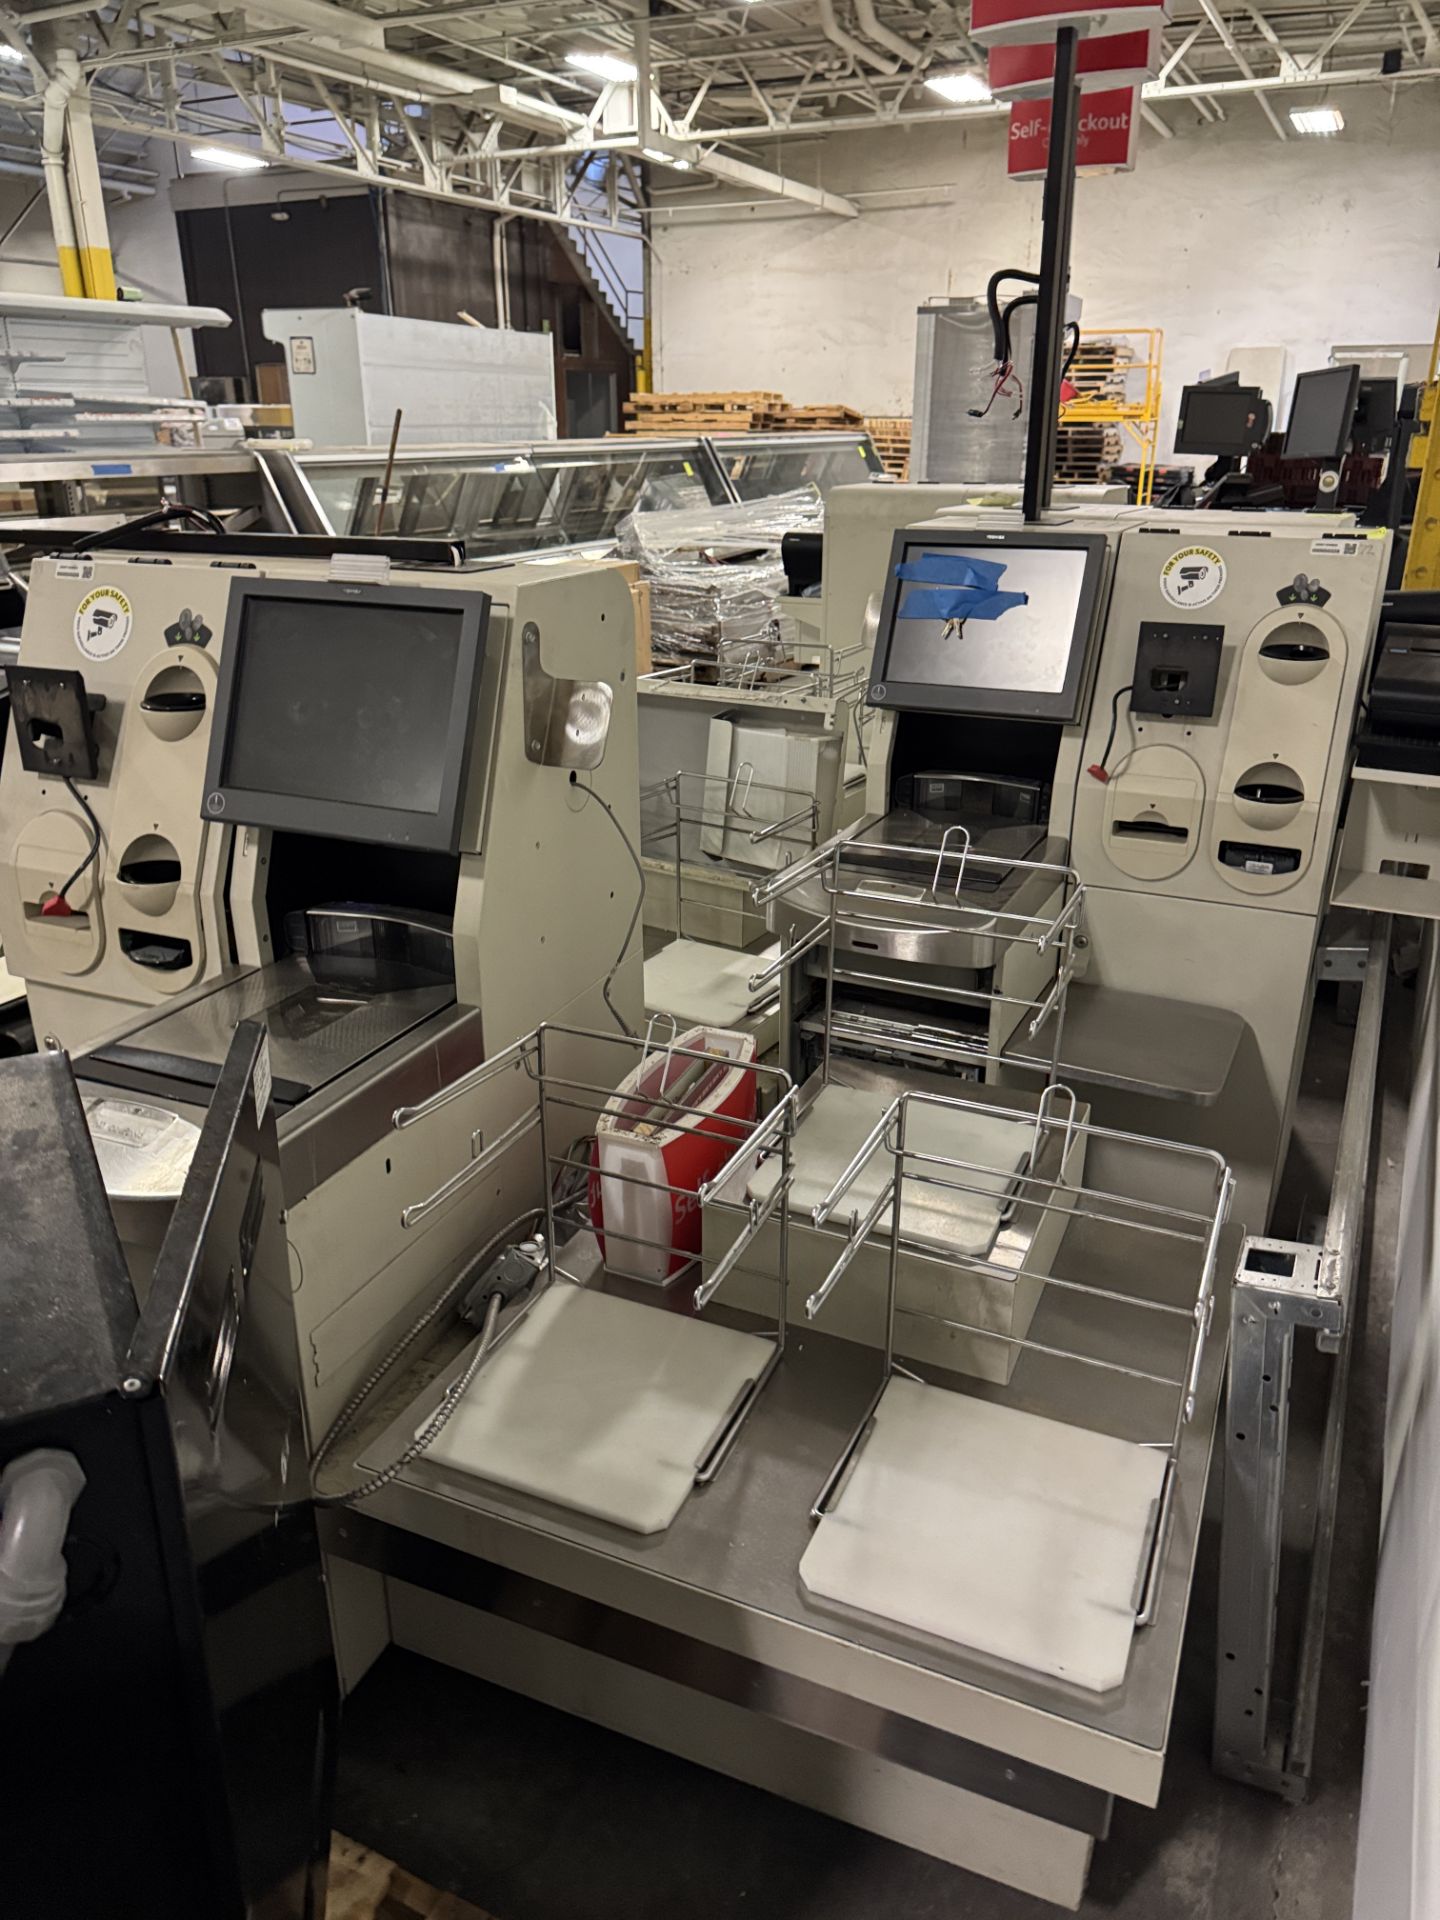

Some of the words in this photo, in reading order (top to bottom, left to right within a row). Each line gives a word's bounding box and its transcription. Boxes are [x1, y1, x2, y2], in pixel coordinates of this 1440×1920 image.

[1163, 561, 1175, 576] FOR
[1174, 549, 1195, 562] YOUR
[1195, 548, 1221, 565] SAFETY
[79, 600, 92, 614] FOR
[91, 589, 109, 600] YOUR
[110, 590, 130, 613] SAFETY
